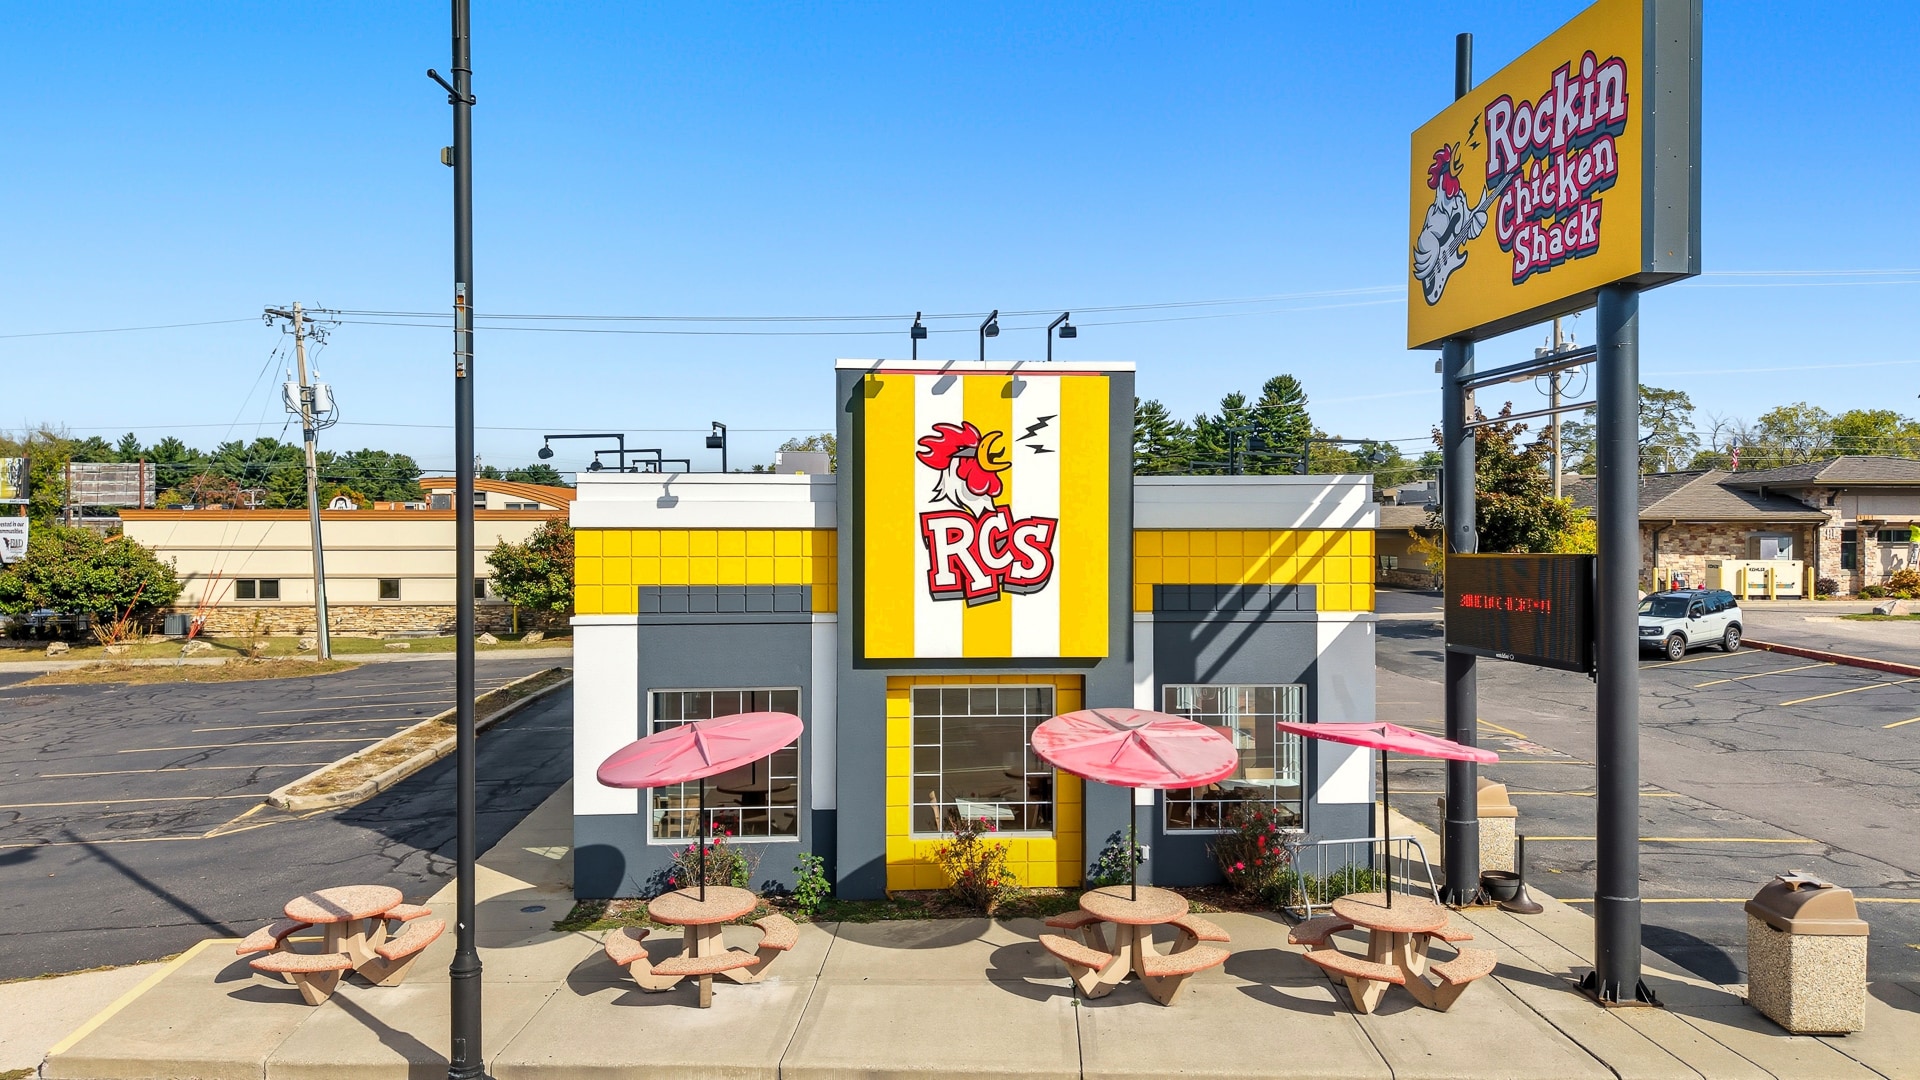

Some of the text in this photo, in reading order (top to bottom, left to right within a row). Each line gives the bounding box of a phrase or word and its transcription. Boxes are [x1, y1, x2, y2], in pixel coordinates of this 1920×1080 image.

[1486, 51, 1628, 181] Rockin
[1497, 136, 1617, 246] Chicken
[1513, 200, 1602, 280] Shack
[920, 505, 1057, 602] RCS
